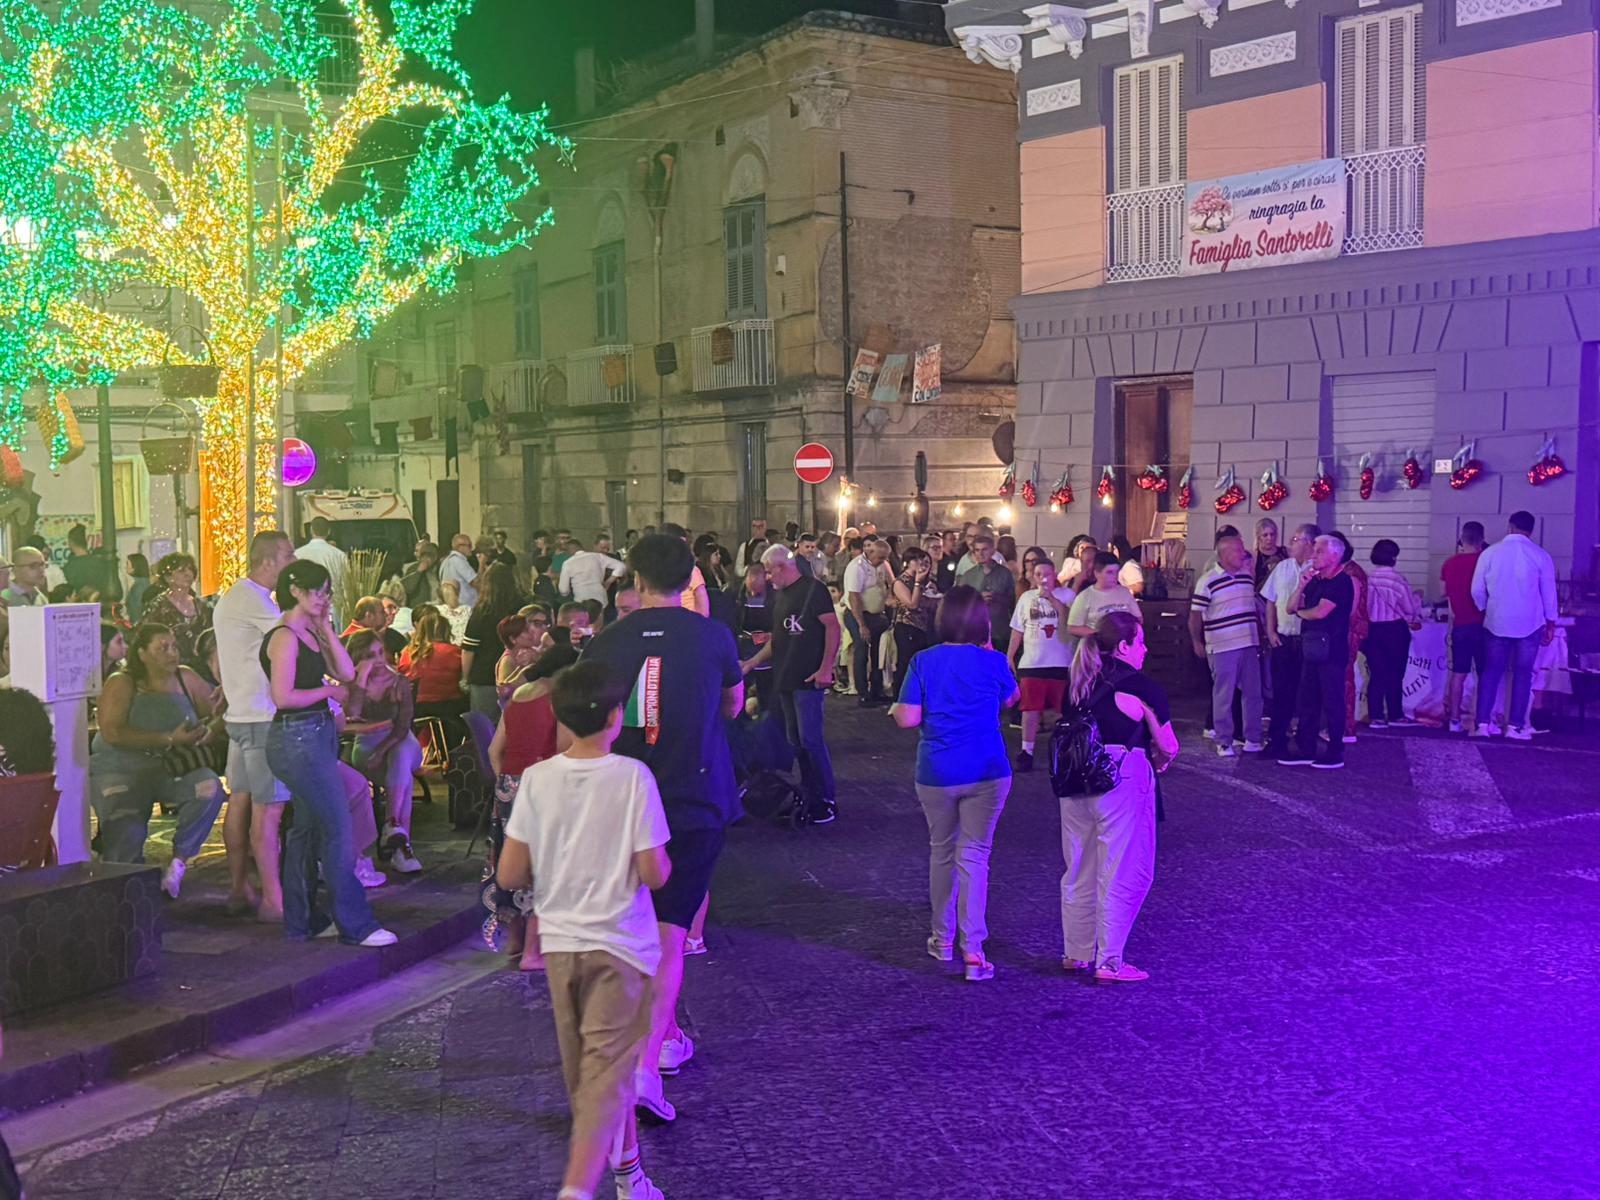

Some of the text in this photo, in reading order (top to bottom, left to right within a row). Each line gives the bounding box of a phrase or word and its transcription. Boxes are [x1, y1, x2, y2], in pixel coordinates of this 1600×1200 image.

[1249, 194, 1326, 225] ringrazia la
[1190, 221, 1333, 272] Famiglia Santorelli
